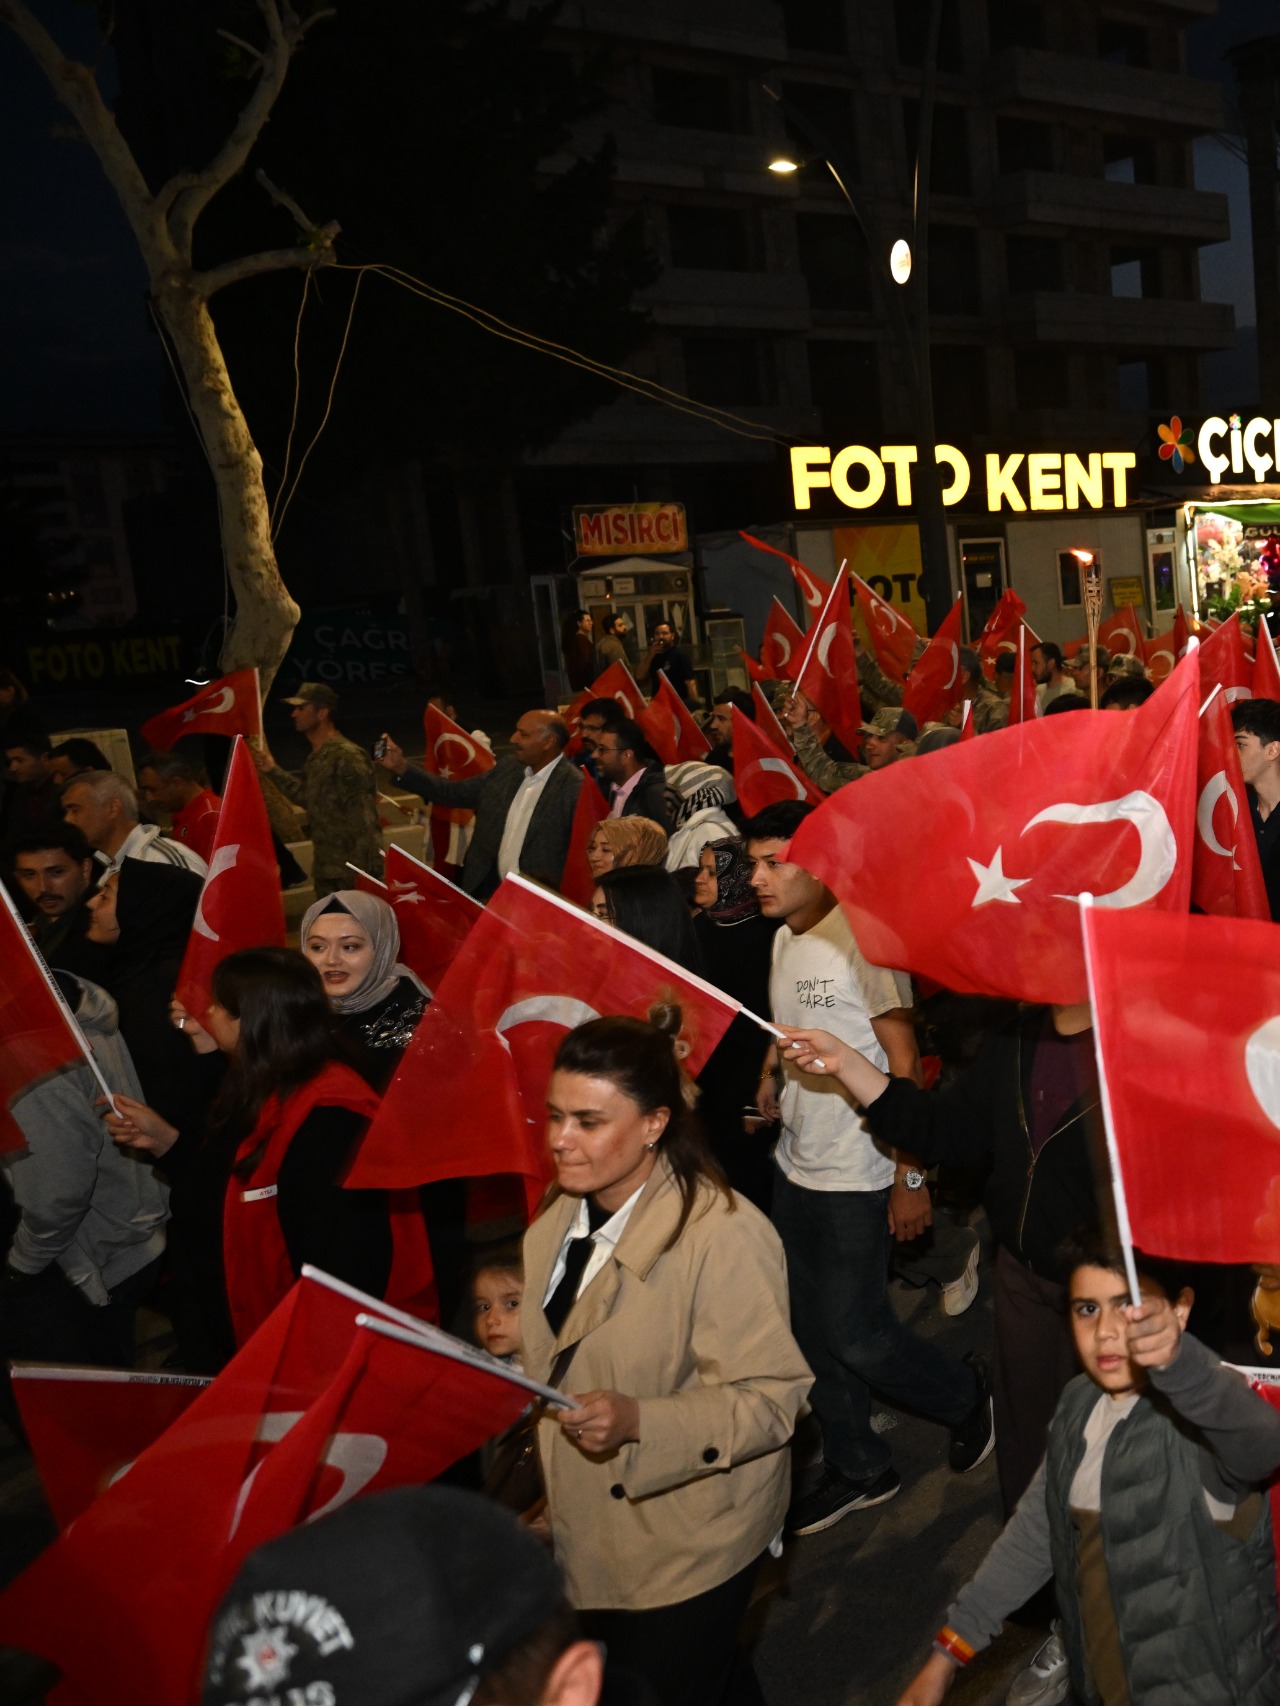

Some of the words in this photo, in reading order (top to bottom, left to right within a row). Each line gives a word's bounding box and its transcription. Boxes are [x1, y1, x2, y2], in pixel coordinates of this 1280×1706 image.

[790, 444, 971, 510] FOTO
[985, 452, 1136, 512] KENT
[313, 622, 411, 655] ÇAĞR
[26, 640, 106, 684] FOTO
[109, 635, 184, 677] KENT
[291, 653, 408, 683] YÖRES
[796, 976, 835, 994] DON'T
[800, 992, 836, 1010] CARE
